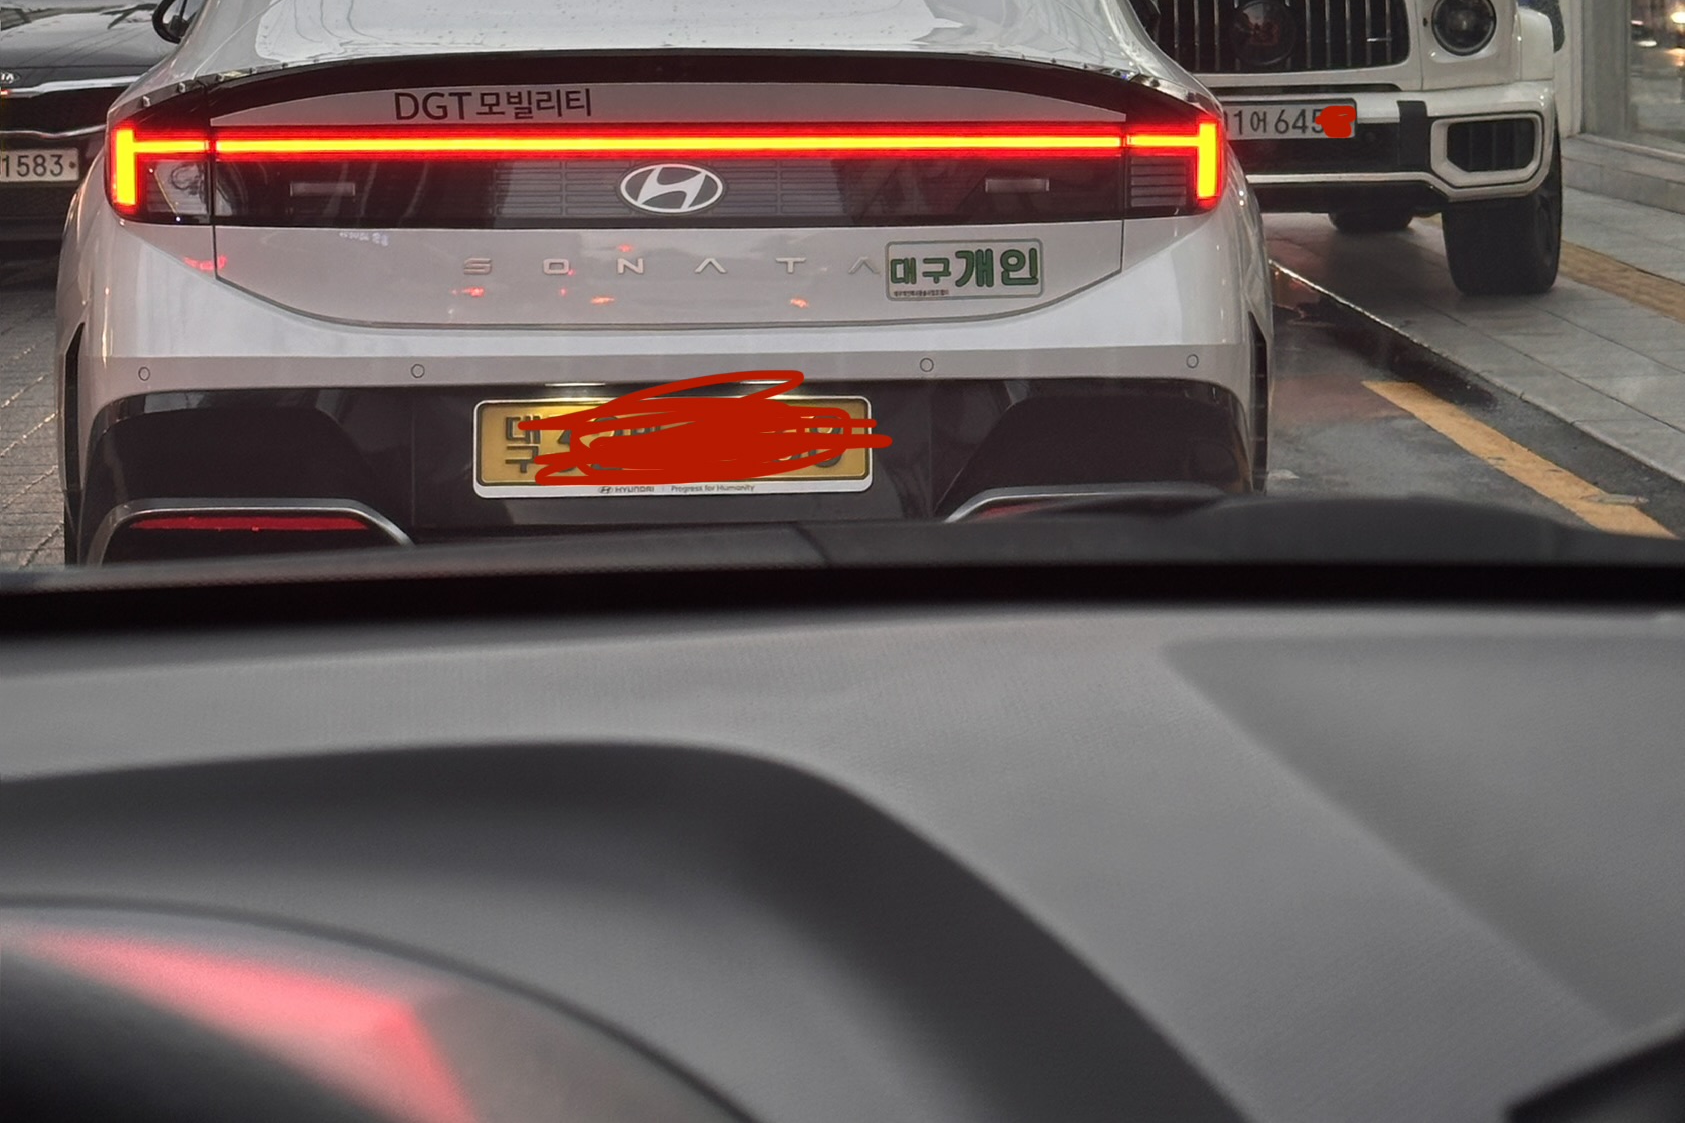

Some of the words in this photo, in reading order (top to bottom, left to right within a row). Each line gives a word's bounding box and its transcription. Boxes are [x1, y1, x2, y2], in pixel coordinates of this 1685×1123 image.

[1, 154, 64, 178] 1583
[463, 257, 880, 276] SONATA
[670, 485, 703, 494] Progress
[704, 484, 715, 492] for
[716, 484, 755, 493] Humanity
